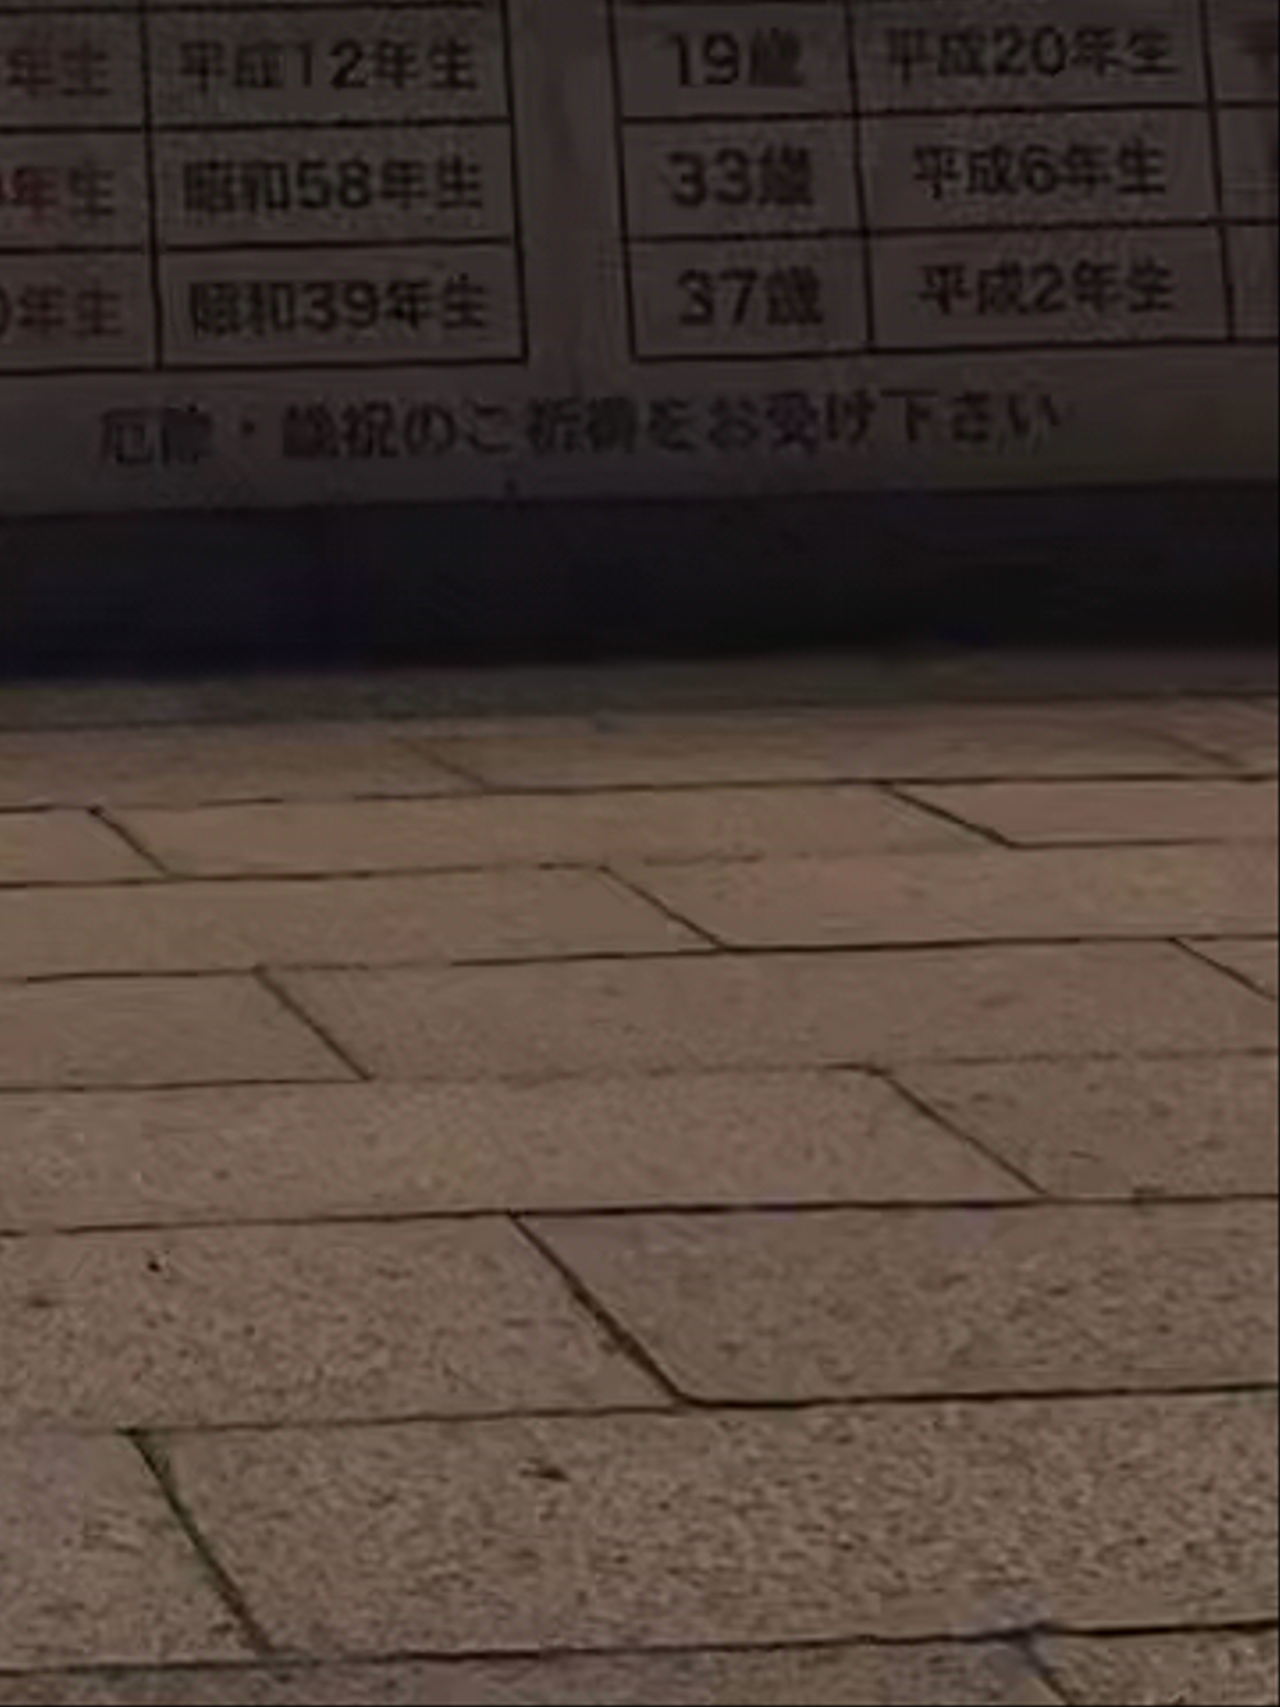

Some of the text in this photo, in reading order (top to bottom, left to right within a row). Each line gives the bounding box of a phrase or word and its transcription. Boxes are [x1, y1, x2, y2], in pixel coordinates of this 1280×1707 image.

[885, 26, 1179, 81] 平成20年生
[913, 142, 1168, 198] 平成6年生
[189, 278, 488, 338] 昭和39年生
[919, 262, 1174, 317] 平成2年生
